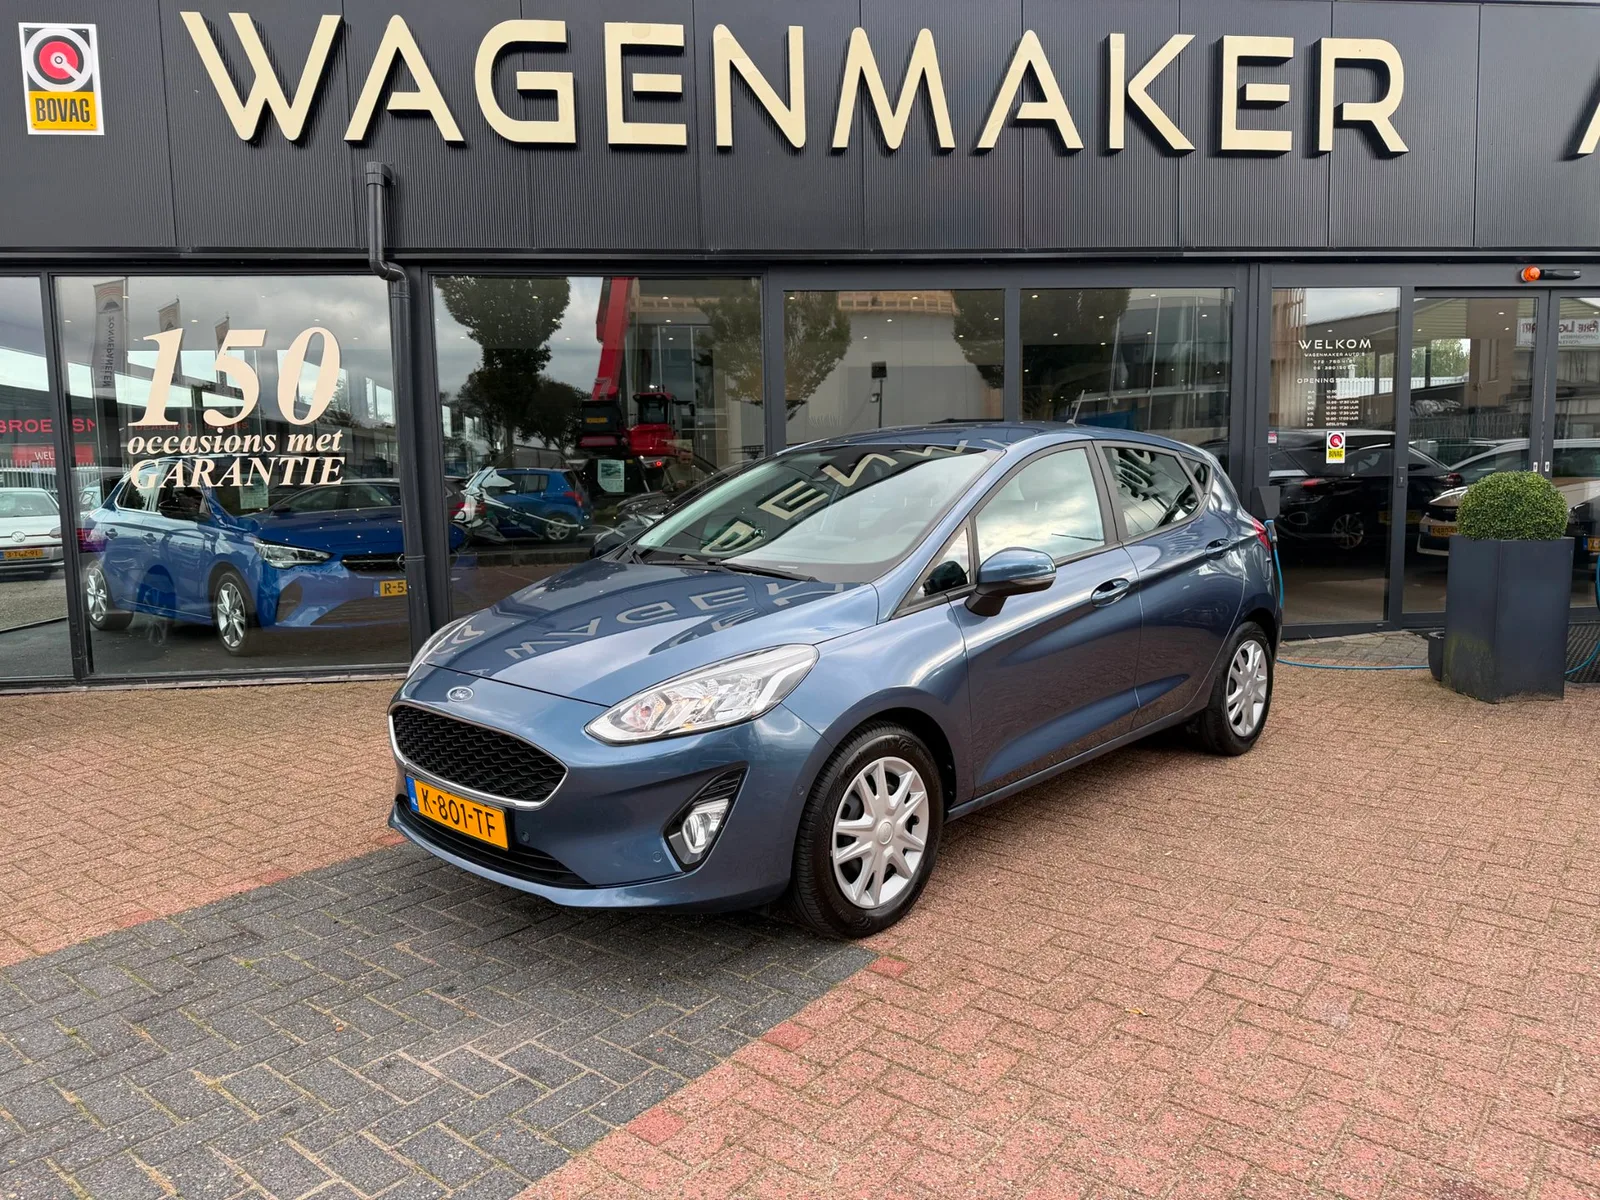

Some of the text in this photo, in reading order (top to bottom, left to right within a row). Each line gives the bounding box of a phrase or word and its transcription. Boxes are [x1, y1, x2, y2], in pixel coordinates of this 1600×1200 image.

[180, 12, 1409, 154] WAGENMAKER
[35, 98, 90, 122] BOVAG
[1298, 339, 1371, 349] WELKOM
[127, 326, 341, 427] 150
[127, 427, 343, 455] occasions met
[130, 456, 345, 489] GARANTIE
[384, 581, 407, 594] R-5
[421, 788, 496, 838] K-801-TF
